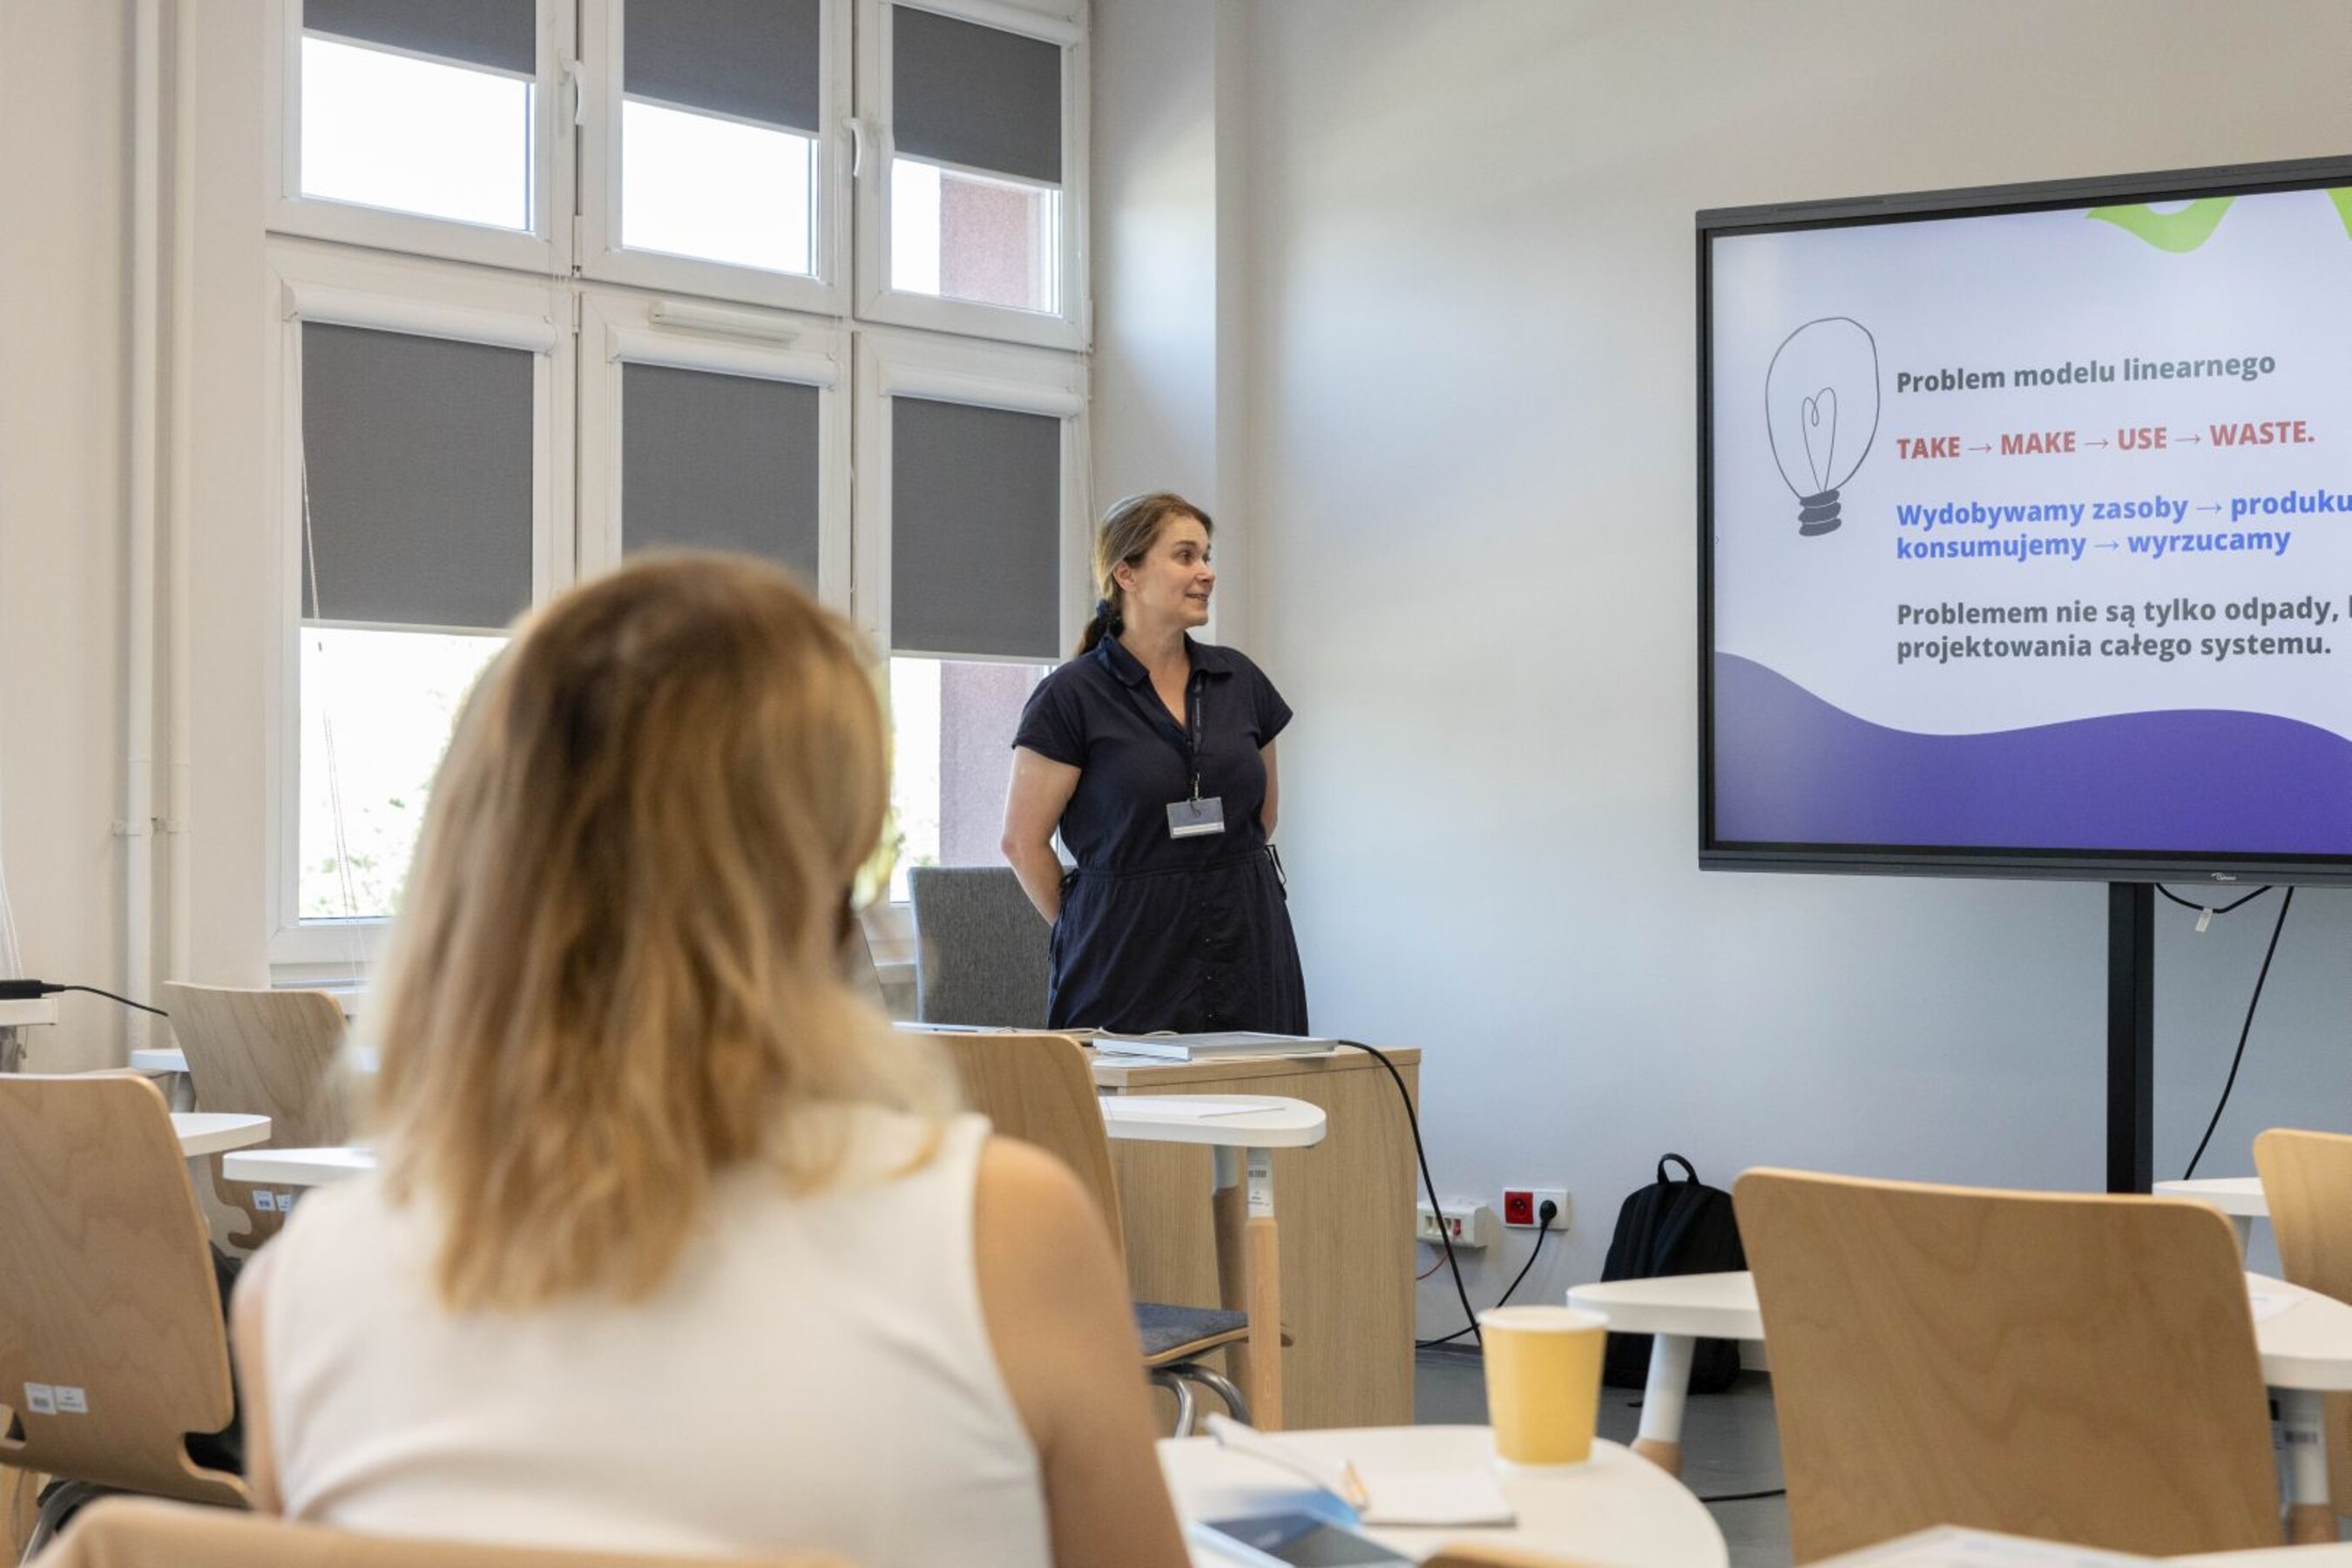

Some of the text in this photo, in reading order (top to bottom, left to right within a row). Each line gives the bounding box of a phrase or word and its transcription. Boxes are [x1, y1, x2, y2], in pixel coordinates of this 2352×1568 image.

[1897, 356, 2275, 393] Problem modelu linearnego
[1896, 421, 2315, 459] TAKE MAKE USE WASTE.
[1897, 502, 2085, 531] Wydobywamy
[2092, 495, 2188, 524] zasoby
[1897, 532, 2291, 562] konsumujemy wyrzucamy
[1898, 602, 2047, 625] Problemem
[2057, 600, 2097, 622] nie
[2106, 605, 2134, 628] są
[2144, 598, 2216, 627] tylko
[2225, 596, 2338, 626] odpady,
[1897, 633, 2331, 665] projektowania całego systemu.
